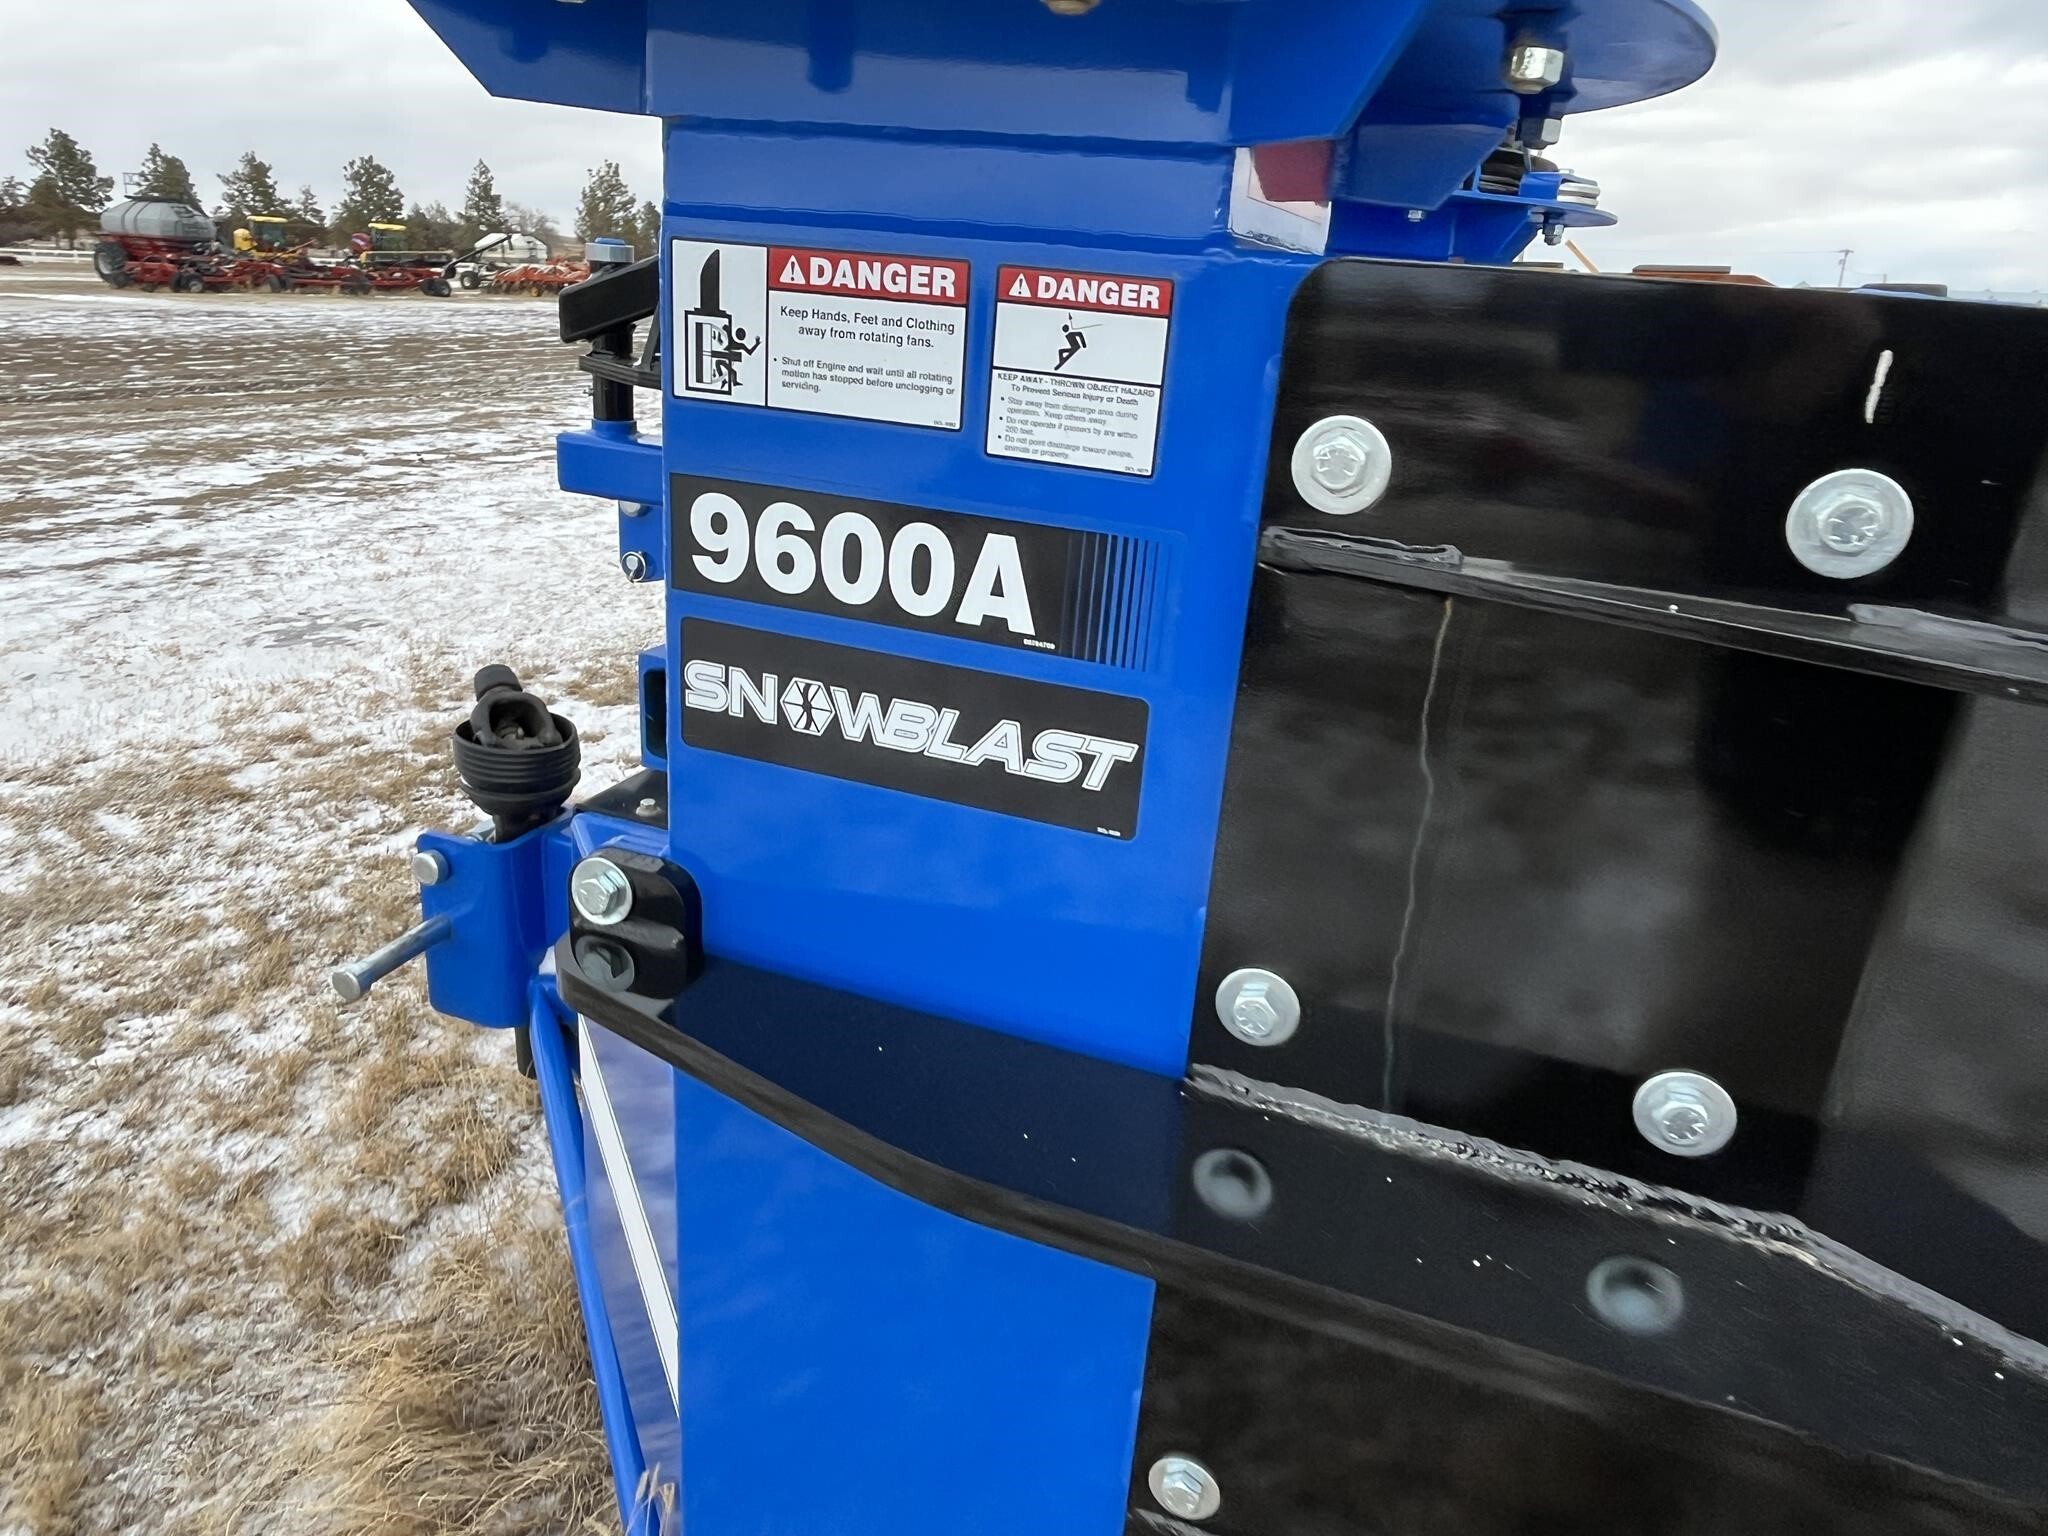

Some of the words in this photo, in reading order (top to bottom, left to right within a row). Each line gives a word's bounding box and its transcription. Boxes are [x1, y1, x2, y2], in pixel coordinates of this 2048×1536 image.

[809, 256, 956, 298] DANGER
[1037, 275, 1160, 309] DANGER
[780, 306, 808, 320] Keep
[812, 309, 850, 324] Hands,
[854, 313, 878, 325] Feet
[882, 317, 903, 328] and
[906, 317, 955, 335] Clothing
[798, 326, 826, 339] away
[830, 327, 856, 340] from
[859, 331, 903, 347] rotating
[907, 335, 935, 348] fans.
[781, 369, 810, 379] motion
[812, 372, 828, 381] has
[830, 374, 864, 385] stopped
[866, 377, 894, 388] before
[895, 381, 944, 396] unclogging
[945, 387, 955, 395] or
[782, 356, 801, 366] Shut
[803, 360, 815, 368] off
[817, 360, 846, 372] Engine
[848, 365, 864, 374] and
[866, 366, 883, 375] wait
[885, 369, 904, 378] until
[906, 370, 917, 379] all
[919, 372, 953, 385] rotating
[997, 372, 1018, 381] KEEP
[1020, 375, 1044, 385] AWAY
[1051, 378, 1085, 389] THROWN
[1087, 383, 1119, 393] OBJECT
[1121, 387, 1155, 397] HAZARD
[781, 380, 821, 393] servicing.
[1022, 386, 1051, 396] Prevent
[1052, 389, 1081, 399] Serious
[1082, 393, 1105, 403] Injury
[1116, 397, 1139, 406] Death
[689, 492, 1036, 636] 9600A
[684, 659, 1139, 792] SNOWBLAST
